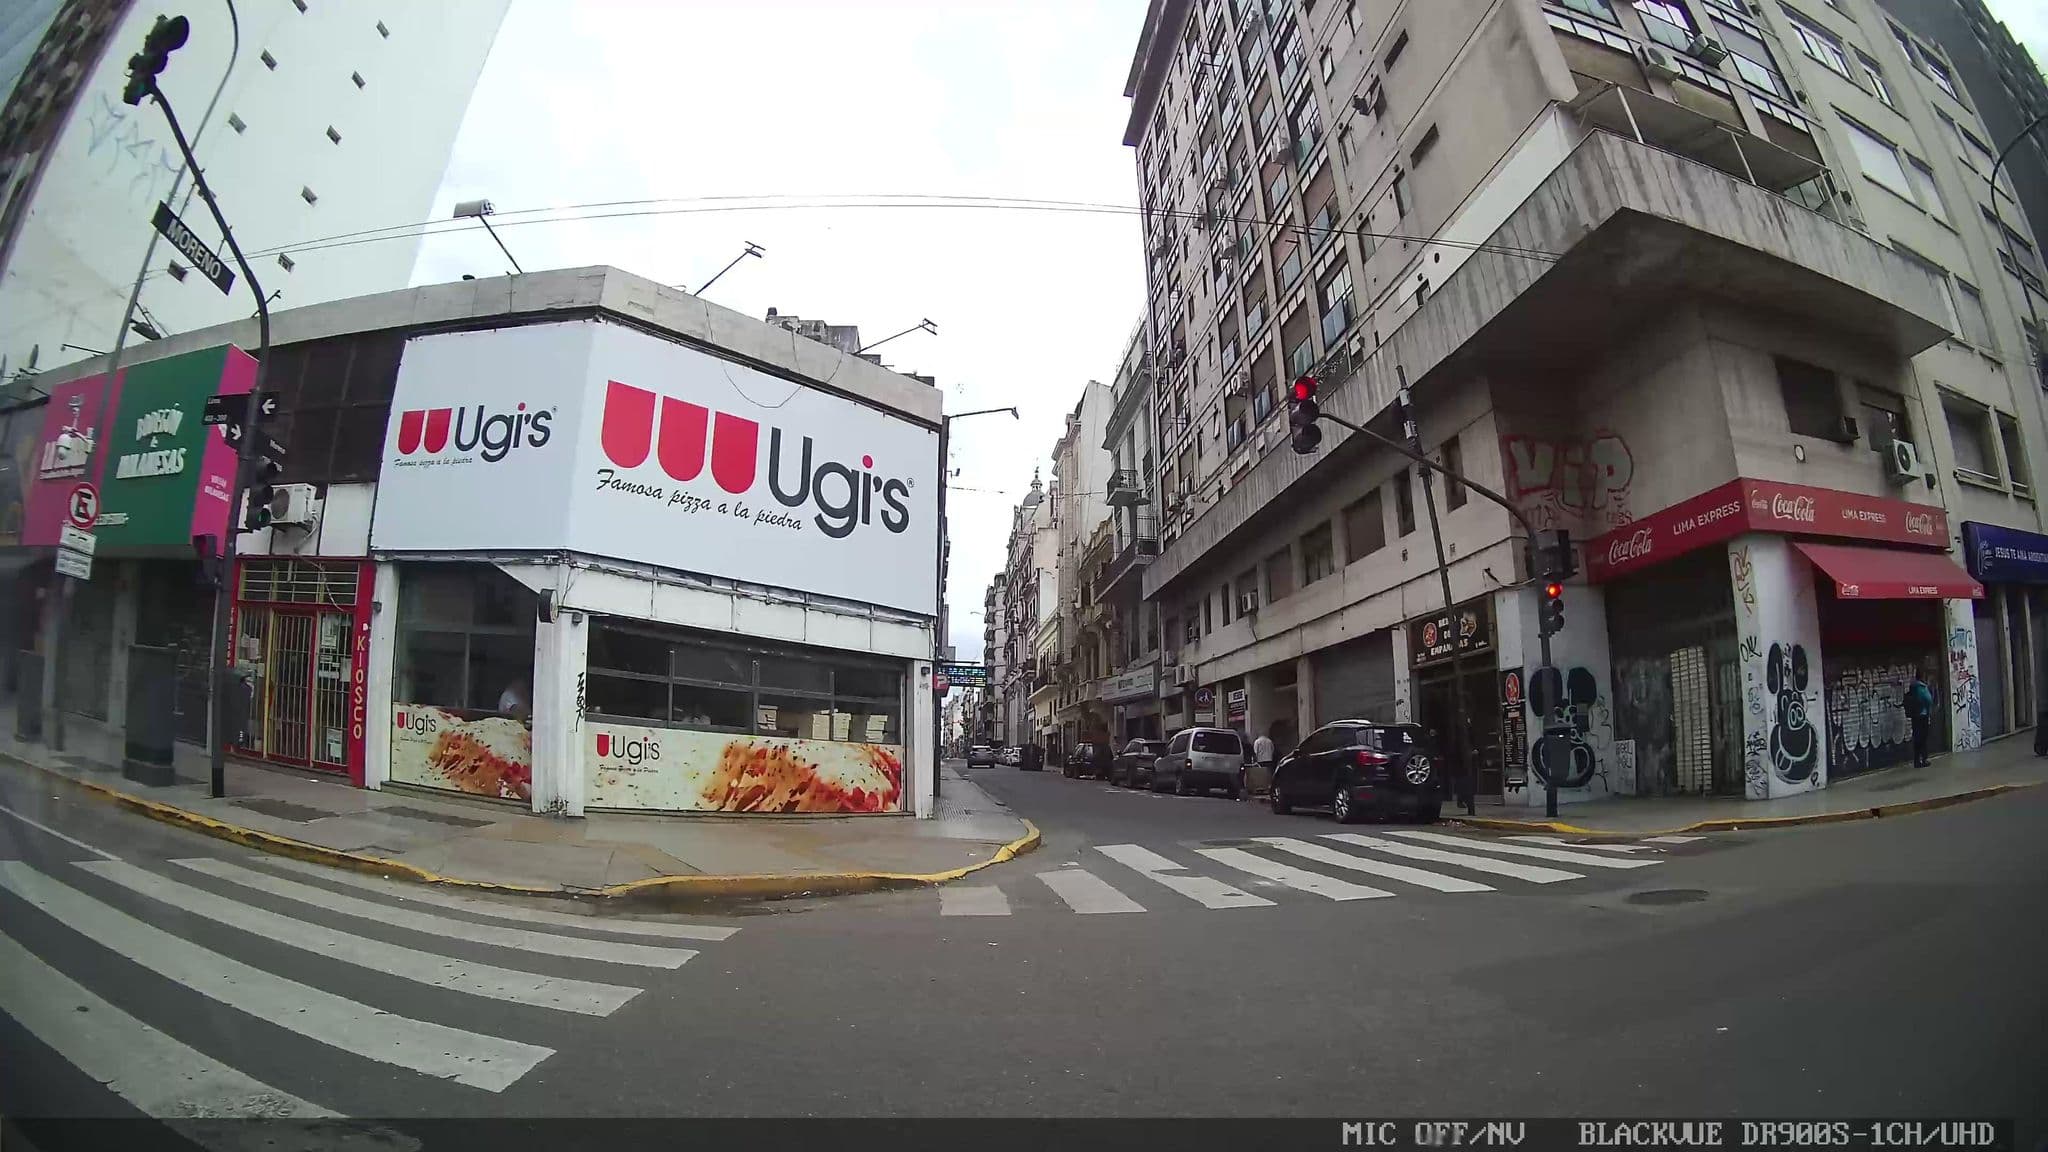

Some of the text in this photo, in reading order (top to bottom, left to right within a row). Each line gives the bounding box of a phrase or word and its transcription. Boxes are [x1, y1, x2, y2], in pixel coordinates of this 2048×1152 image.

[167, 219, 221, 279] MORENO
[455, 402, 553, 463] Ugi's
[597, 469, 803, 531] Famosa pizza a la piedra
[768, 426, 910, 539] Ugi's
[1673, 519, 1696, 536] LIMA
[1697, 501, 1741, 527] EXPRESS
[1842, 508, 1859, 520] LIMA
[352, 635, 366, 739] KIOSCO
